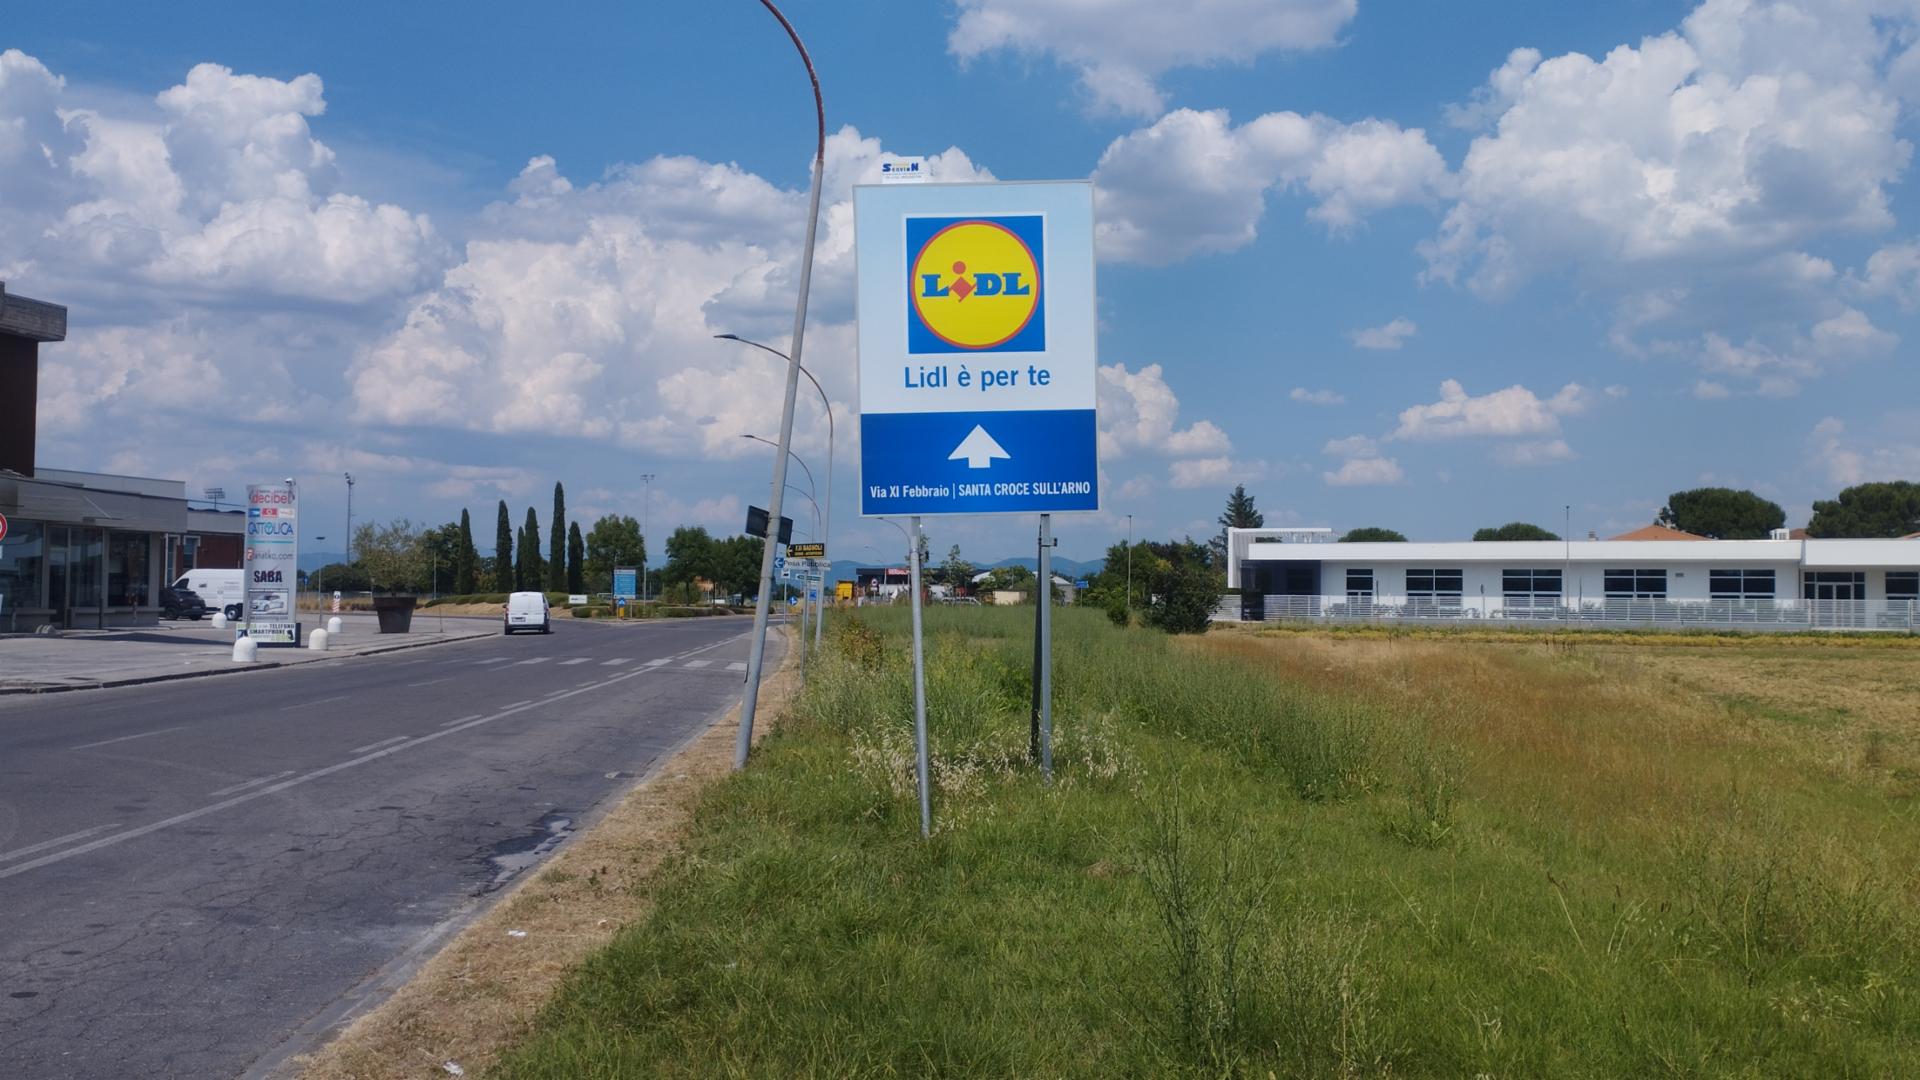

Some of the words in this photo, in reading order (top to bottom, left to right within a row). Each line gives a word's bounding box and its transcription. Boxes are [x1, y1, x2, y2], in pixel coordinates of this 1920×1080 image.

[904, 366, 948, 388] Lidl
[957, 364, 971, 387] è
[980, 369, 1019, 391] per
[1027, 365, 1051, 386] te
[870, 485, 887, 498] Via
[889, 485, 900, 498] XI
[903, 484, 949, 498] Febbraio
[958, 483, 992, 497] SANTA
[994, 482, 1030, 496] CROCE
[1032, 481, 1091, 495] SULL'ARNO
[248, 522, 294, 536] CATTOLICA
[254, 570, 283, 583] SABA
